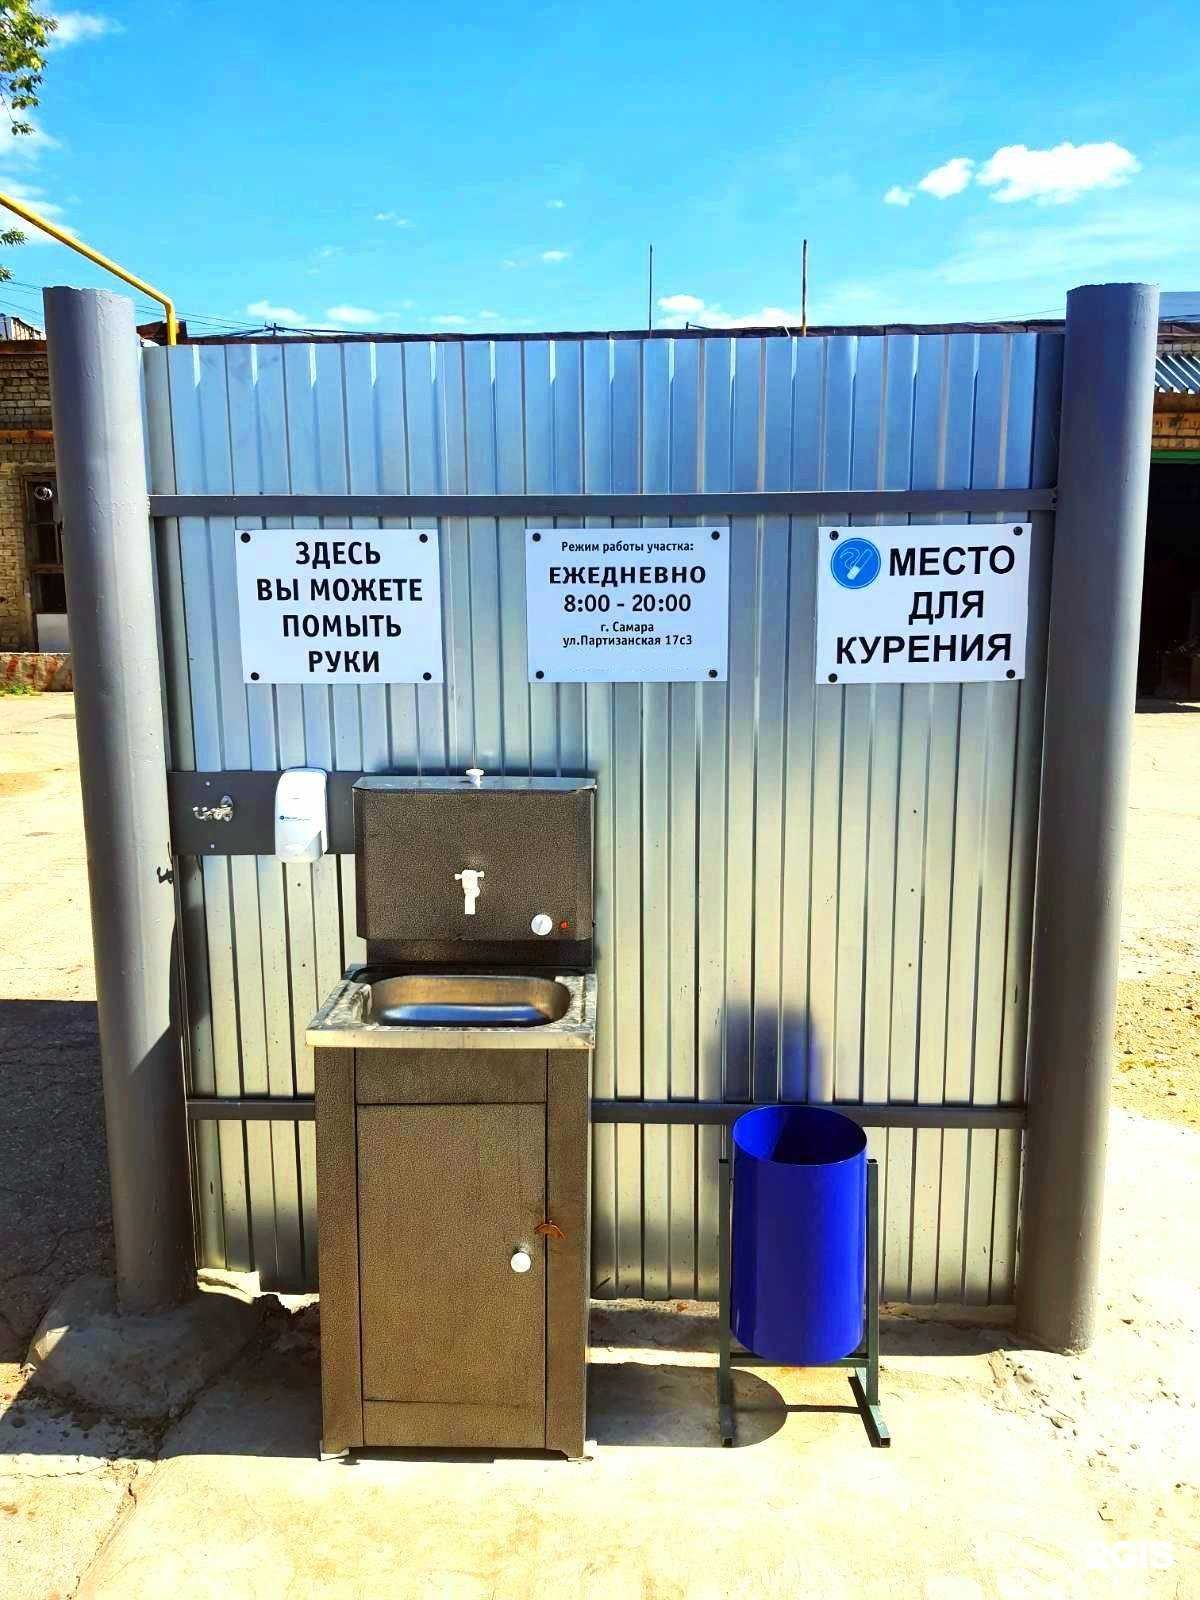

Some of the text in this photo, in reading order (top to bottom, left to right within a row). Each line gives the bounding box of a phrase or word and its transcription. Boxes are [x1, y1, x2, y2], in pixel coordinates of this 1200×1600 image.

[295, 541, 381, 570] ЗДЕСЬ
[561, 540, 694, 554] Режим работы участка:
[889, 544, 1015, 577] МЕСТО
[549, 565, 706, 588] ЕЖЕДНЕВНО
[256, 578, 423, 602] ВЫ МОЖЕТЕ
[563, 594, 610, 613] 8:00
[632, 593, 691, 612] 20:00
[908, 590, 984, 626] ДЛЯ
[282, 614, 402, 638] ПОМЫТЬ
[600, 621, 654, 634] г. Самара
[562, 634, 692, 648] ул.Партизанская 17с3
[836, 633, 1012, 665] КУРЕНИЯ
[308, 650, 380, 673] РУКИ
